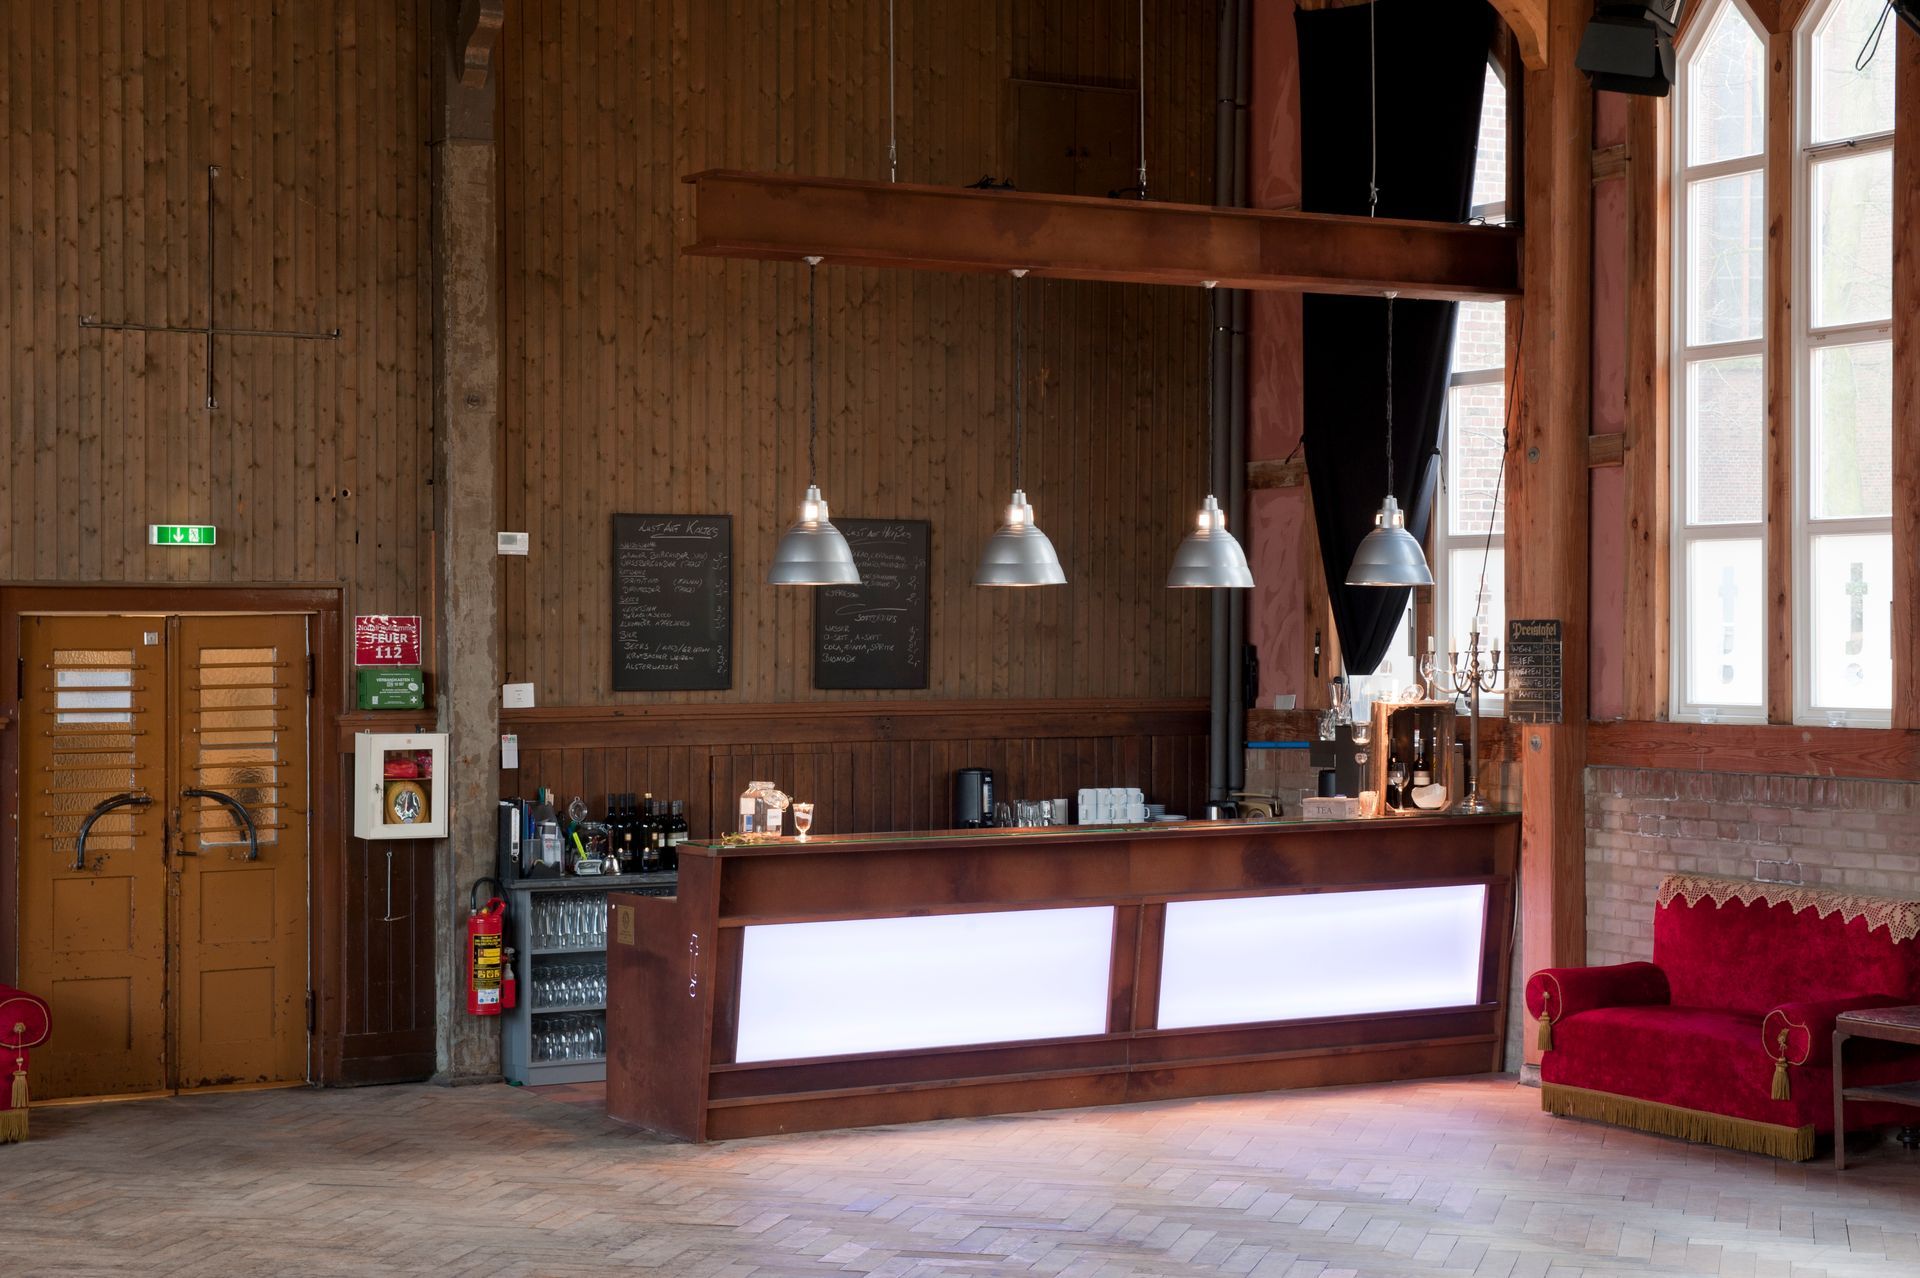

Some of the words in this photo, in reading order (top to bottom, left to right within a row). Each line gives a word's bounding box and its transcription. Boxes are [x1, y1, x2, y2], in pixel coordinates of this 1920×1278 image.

[371, 633, 408, 643] FEUER
[375, 646, 403, 659] 112
[1317, 807, 1333, 815] TEA
